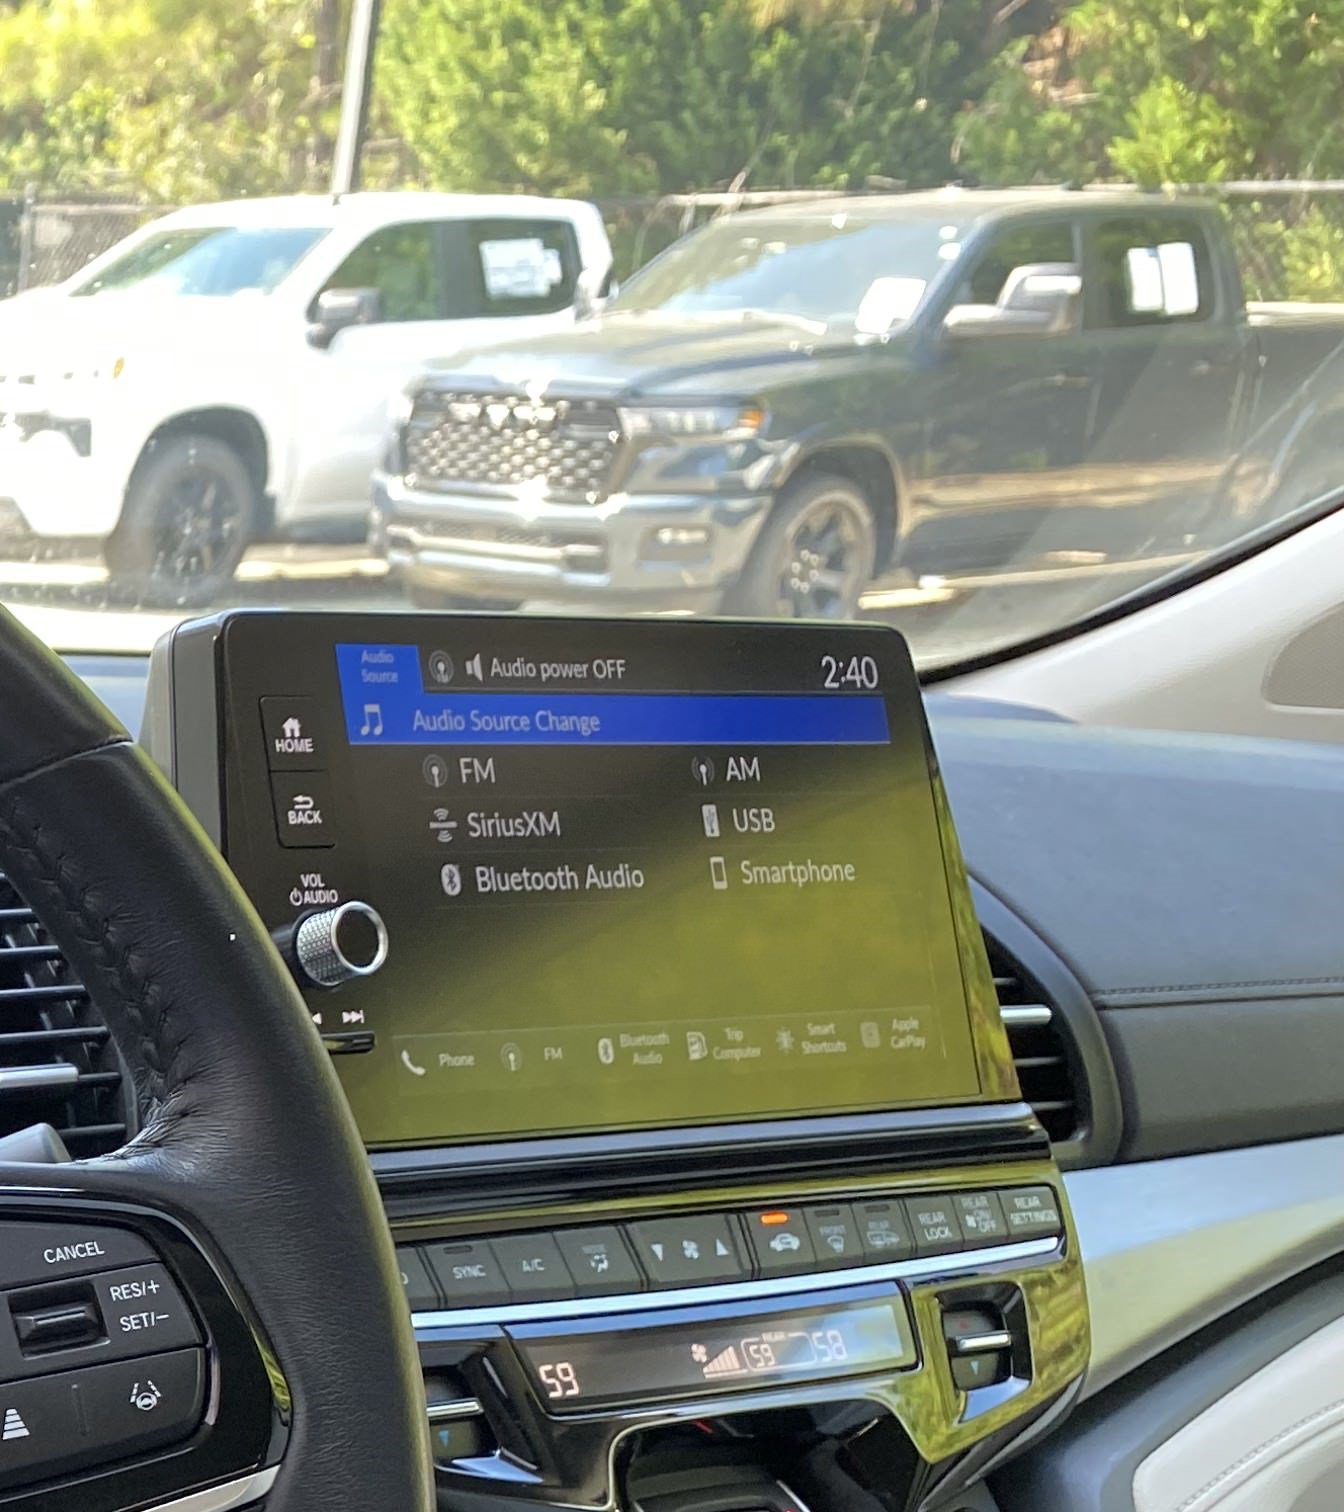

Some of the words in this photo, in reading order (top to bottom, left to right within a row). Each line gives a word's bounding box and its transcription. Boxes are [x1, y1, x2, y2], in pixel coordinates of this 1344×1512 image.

[490, 657, 537, 678] Audio
[541, 662, 589, 682] power
[593, 659, 626, 679] OFF
[821, 655, 879, 689] 2:40
[413, 709, 465, 732] Audio
[470, 710, 530, 731] Source
[535, 710, 601, 736] Change
[275, 739, 313, 752] HOME
[459, 757, 496, 784] FM
[726, 756, 761, 782] AM
[288, 810, 322, 825] BACK
[467, 811, 561, 838] SiriusXM
[732, 807, 776, 832] USB
[300, 873, 325, 887] VOL
[475, 865, 579, 893] Bluetooth
[584, 863, 645, 890] Audio
[740, 859, 856, 888] Smartphone
[303, 889, 339, 904] AUDIO
[439, 1053, 475, 1067] Phone
[544, 1047, 563, 1061] FM
[923, 1226, 952, 1240] LOCK
[43, 1241, 105, 1264] CANCEL
[452, 1265, 486, 1279] SYNC
[522, 1258, 545, 1273] A/C
[109, 1279, 161, 1302] RES/+
[749, 1343, 776, 1368] 59
[813, 1329, 848, 1362] 58
[538, 1362, 580, 1399] 59
